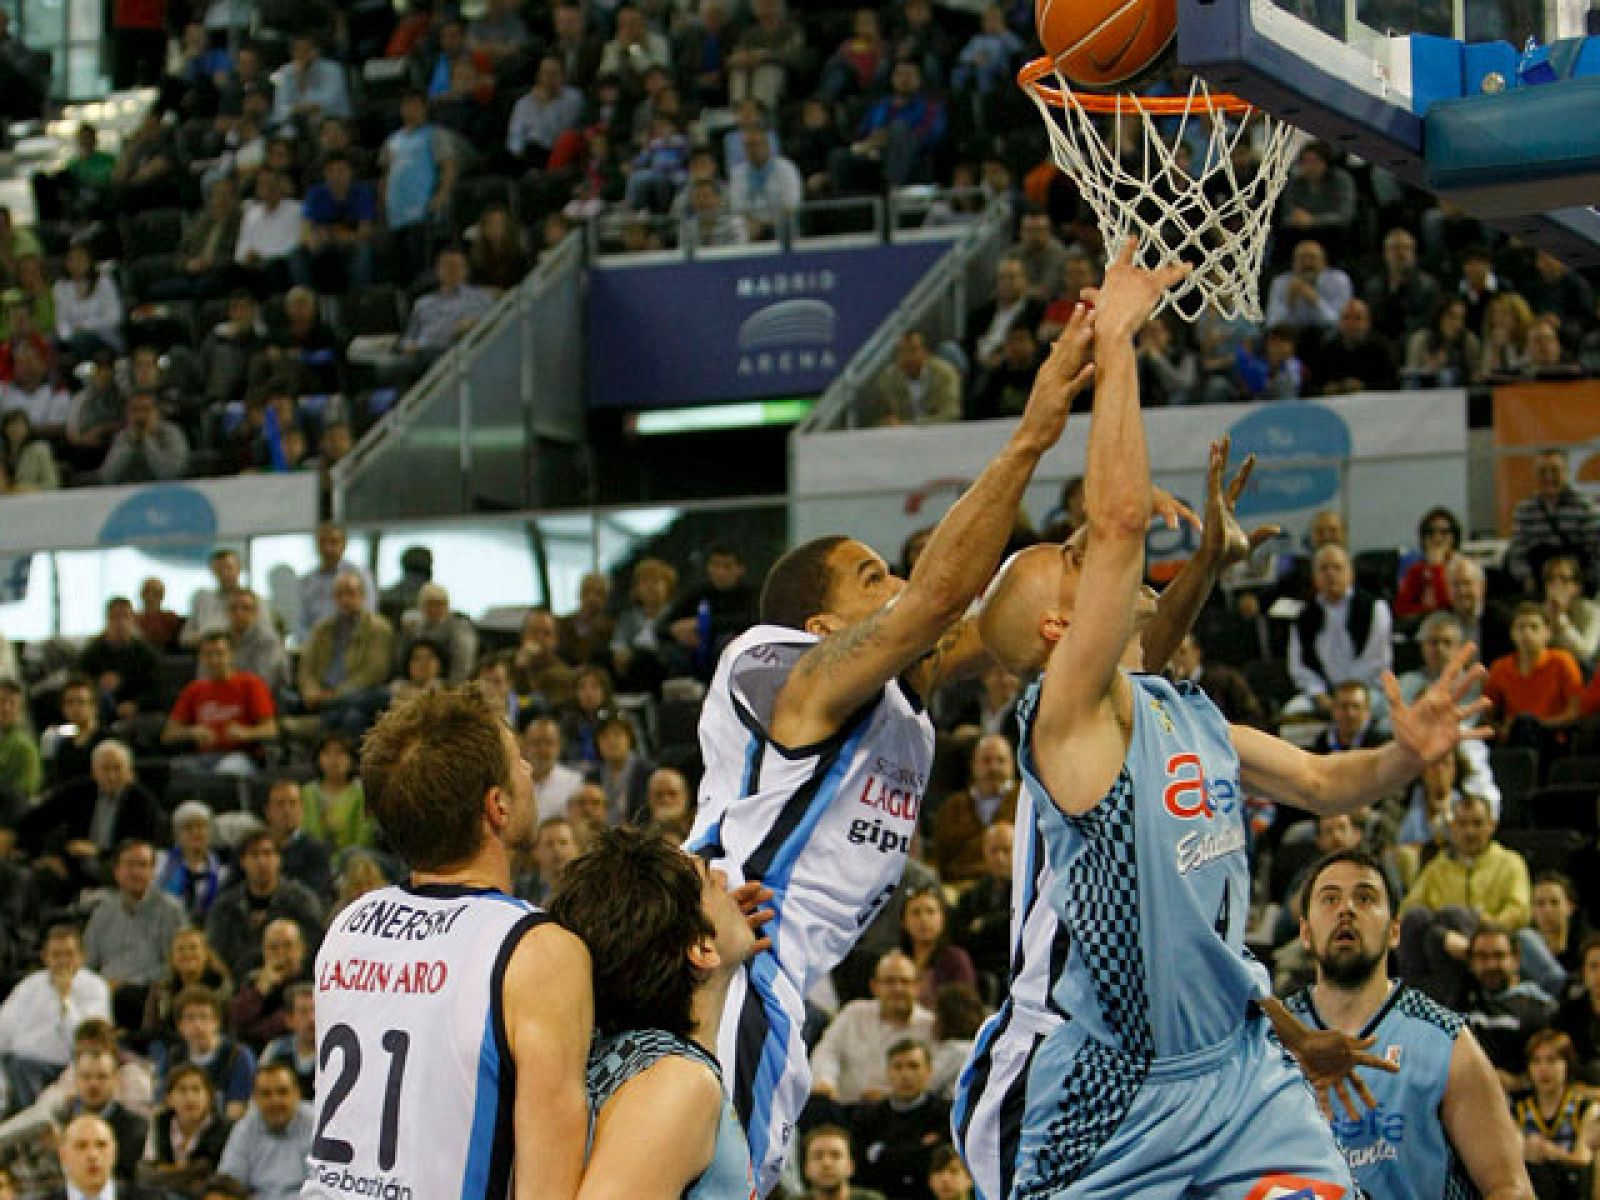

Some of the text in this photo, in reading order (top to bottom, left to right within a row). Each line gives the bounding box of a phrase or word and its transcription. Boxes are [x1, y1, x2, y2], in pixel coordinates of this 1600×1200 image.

[737, 270, 834, 296] MADRID
[737, 351, 836, 376] ARENA
[339, 899, 469, 941] IGNERSKI
[319, 959, 449, 994] LAGUN ARO
[311, 1022, 411, 1173] 21
